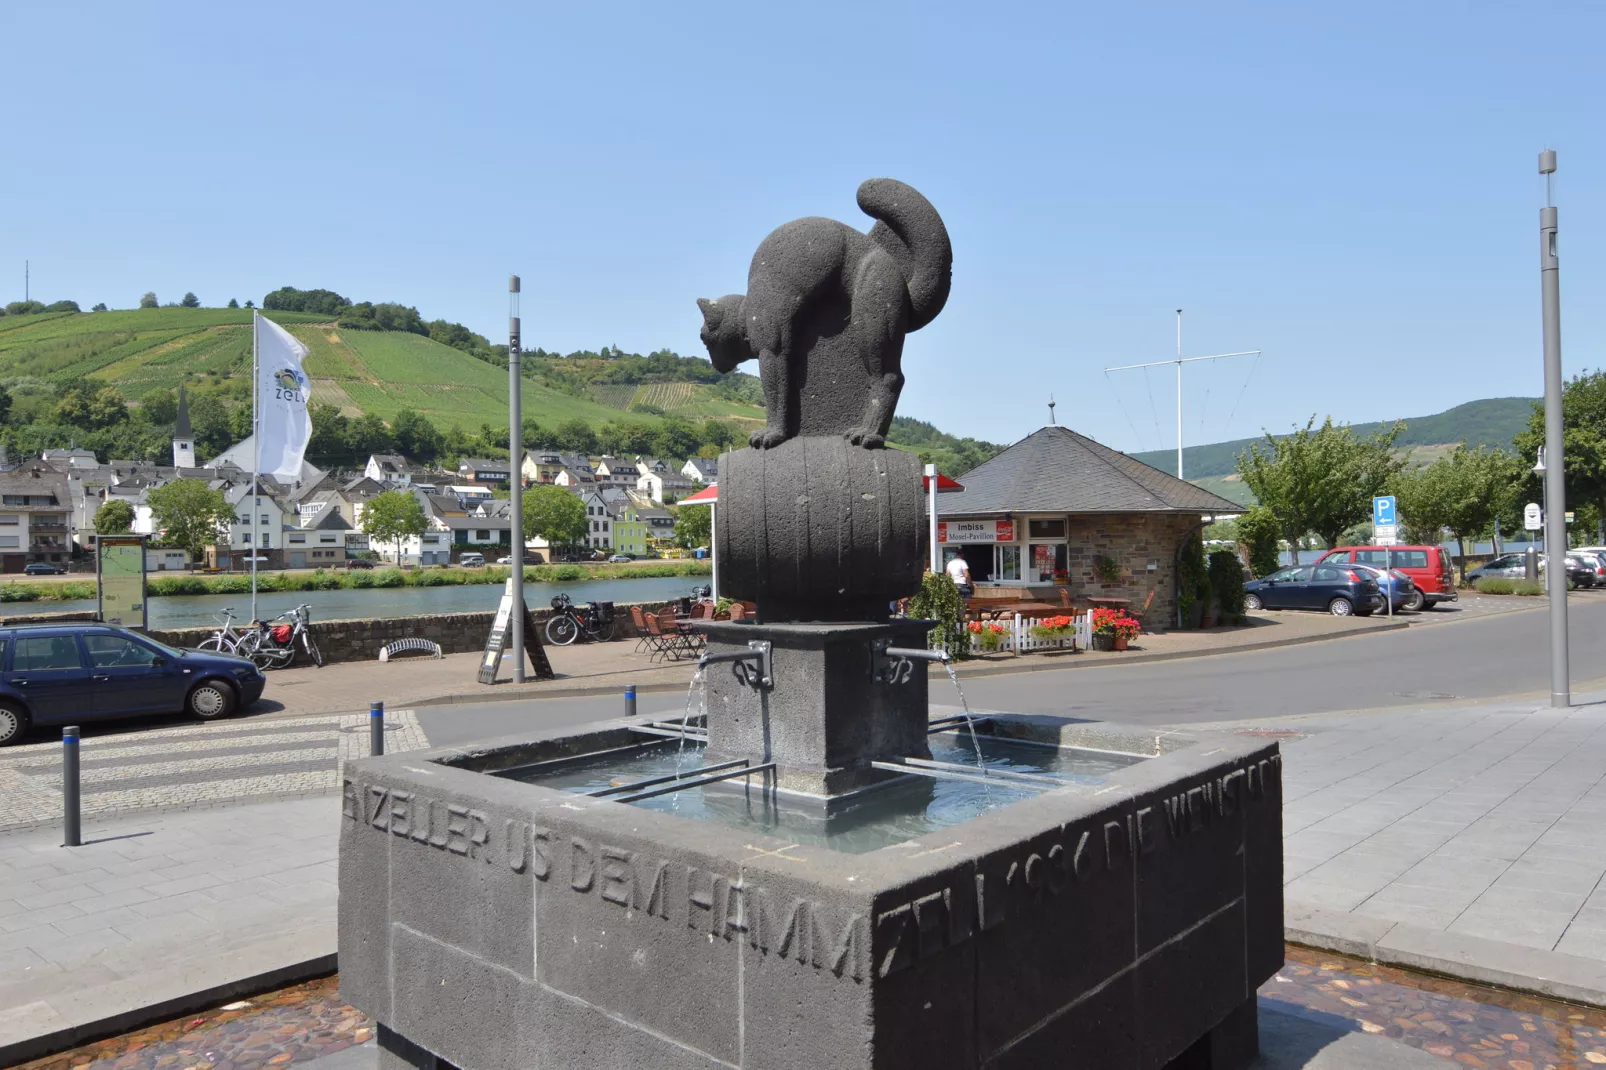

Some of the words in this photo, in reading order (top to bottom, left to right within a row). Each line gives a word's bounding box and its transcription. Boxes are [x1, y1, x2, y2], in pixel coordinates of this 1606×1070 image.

[949, 533, 994, 541] Mosel-Pavillon
[1377, 499, 1390, 517] P
[370, 784, 493, 866] ZELLER
[570, 834, 670, 922] DEM
[686, 865, 867, 987] HAMM
[875, 872, 1006, 980] ZELL
[1103, 805, 1154, 872] DIE
